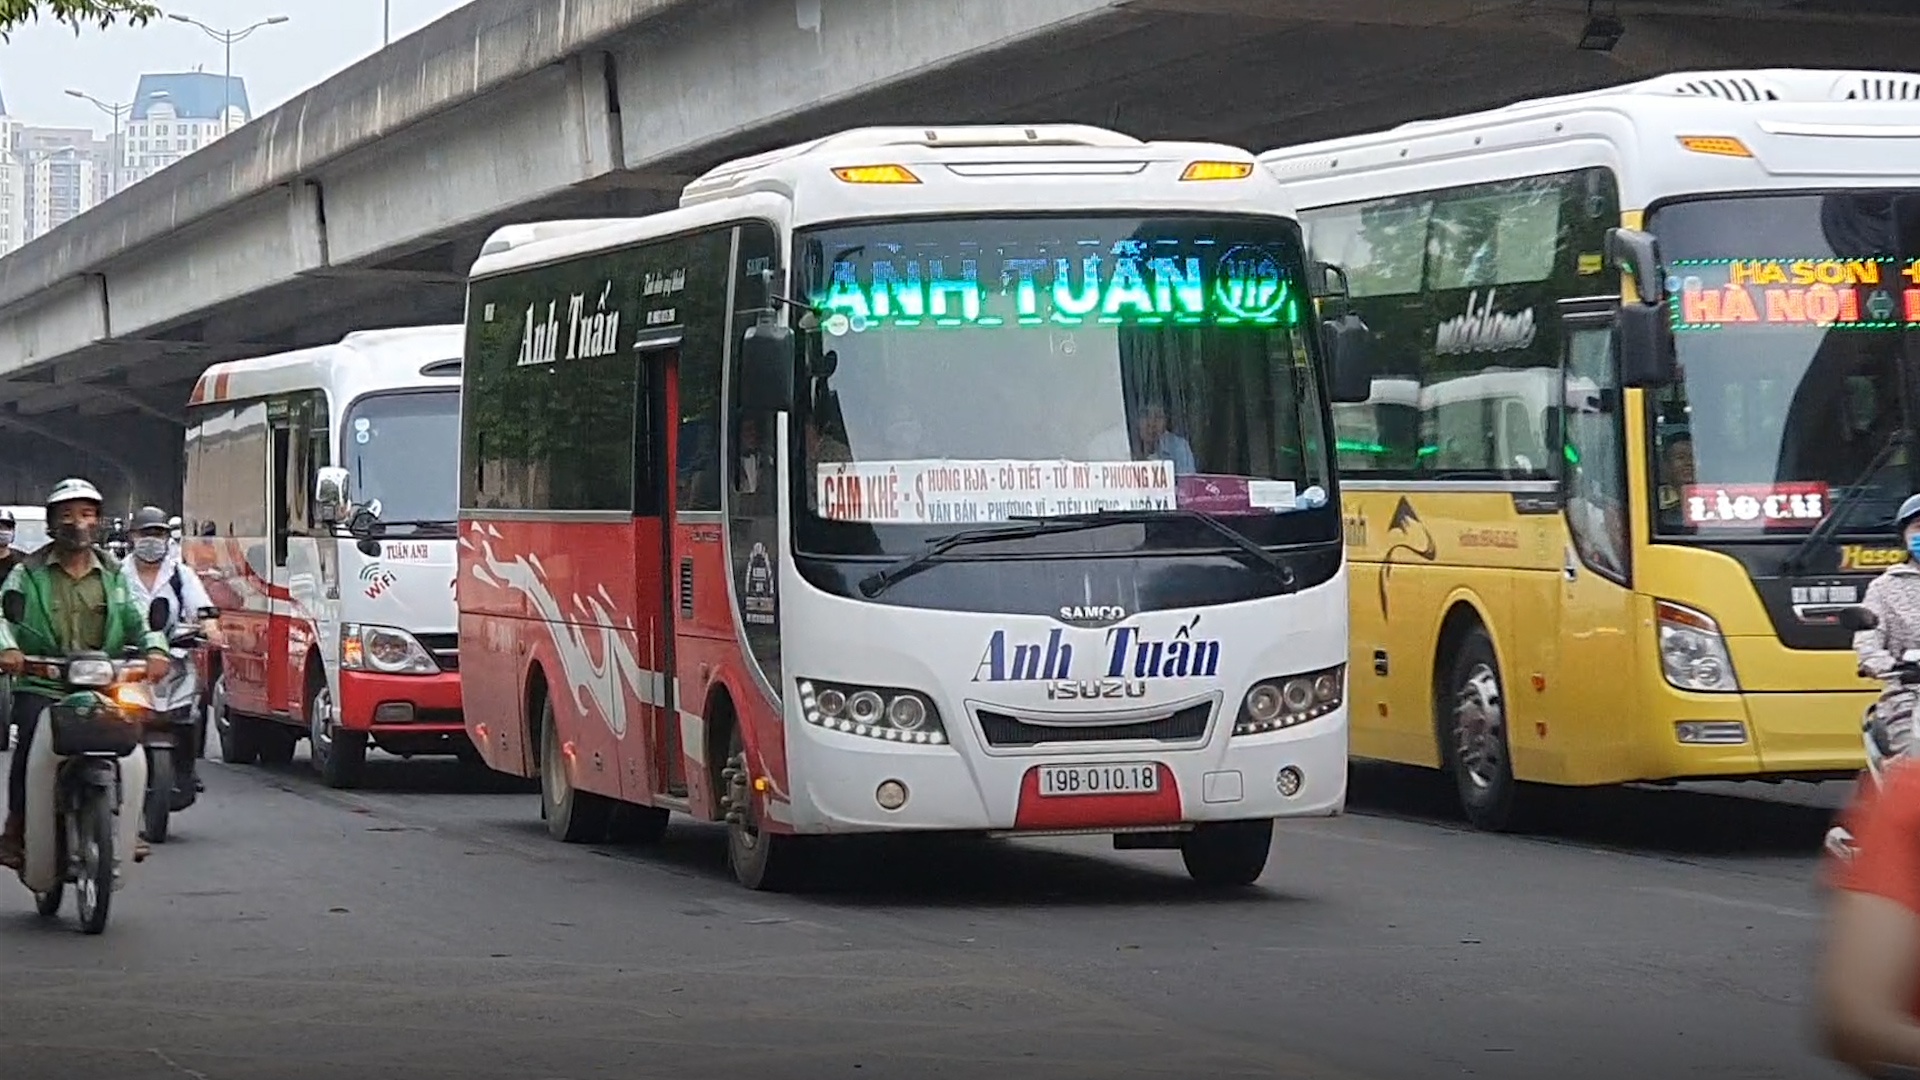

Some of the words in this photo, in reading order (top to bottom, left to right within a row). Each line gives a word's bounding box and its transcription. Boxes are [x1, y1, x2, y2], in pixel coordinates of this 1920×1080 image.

[826, 259, 980, 320] ANH
[1684, 283, 1760, 322] HÀ
[516, 299, 559, 366] Anh
[565, 279, 620, 360] Tuấn
[867, 466, 899, 519] KHÊ
[410, 544, 428, 559] ANH
[364, 570, 397, 599] WiFi
[1060, 606, 1125, 620] SAMCO
[971, 628, 1073, 682] Anh
[1104, 614, 1220, 679] Tuấn
[1047, 681, 1146, 700] ISUZU
[1046, 766, 1153, 792] 19B-010.18
